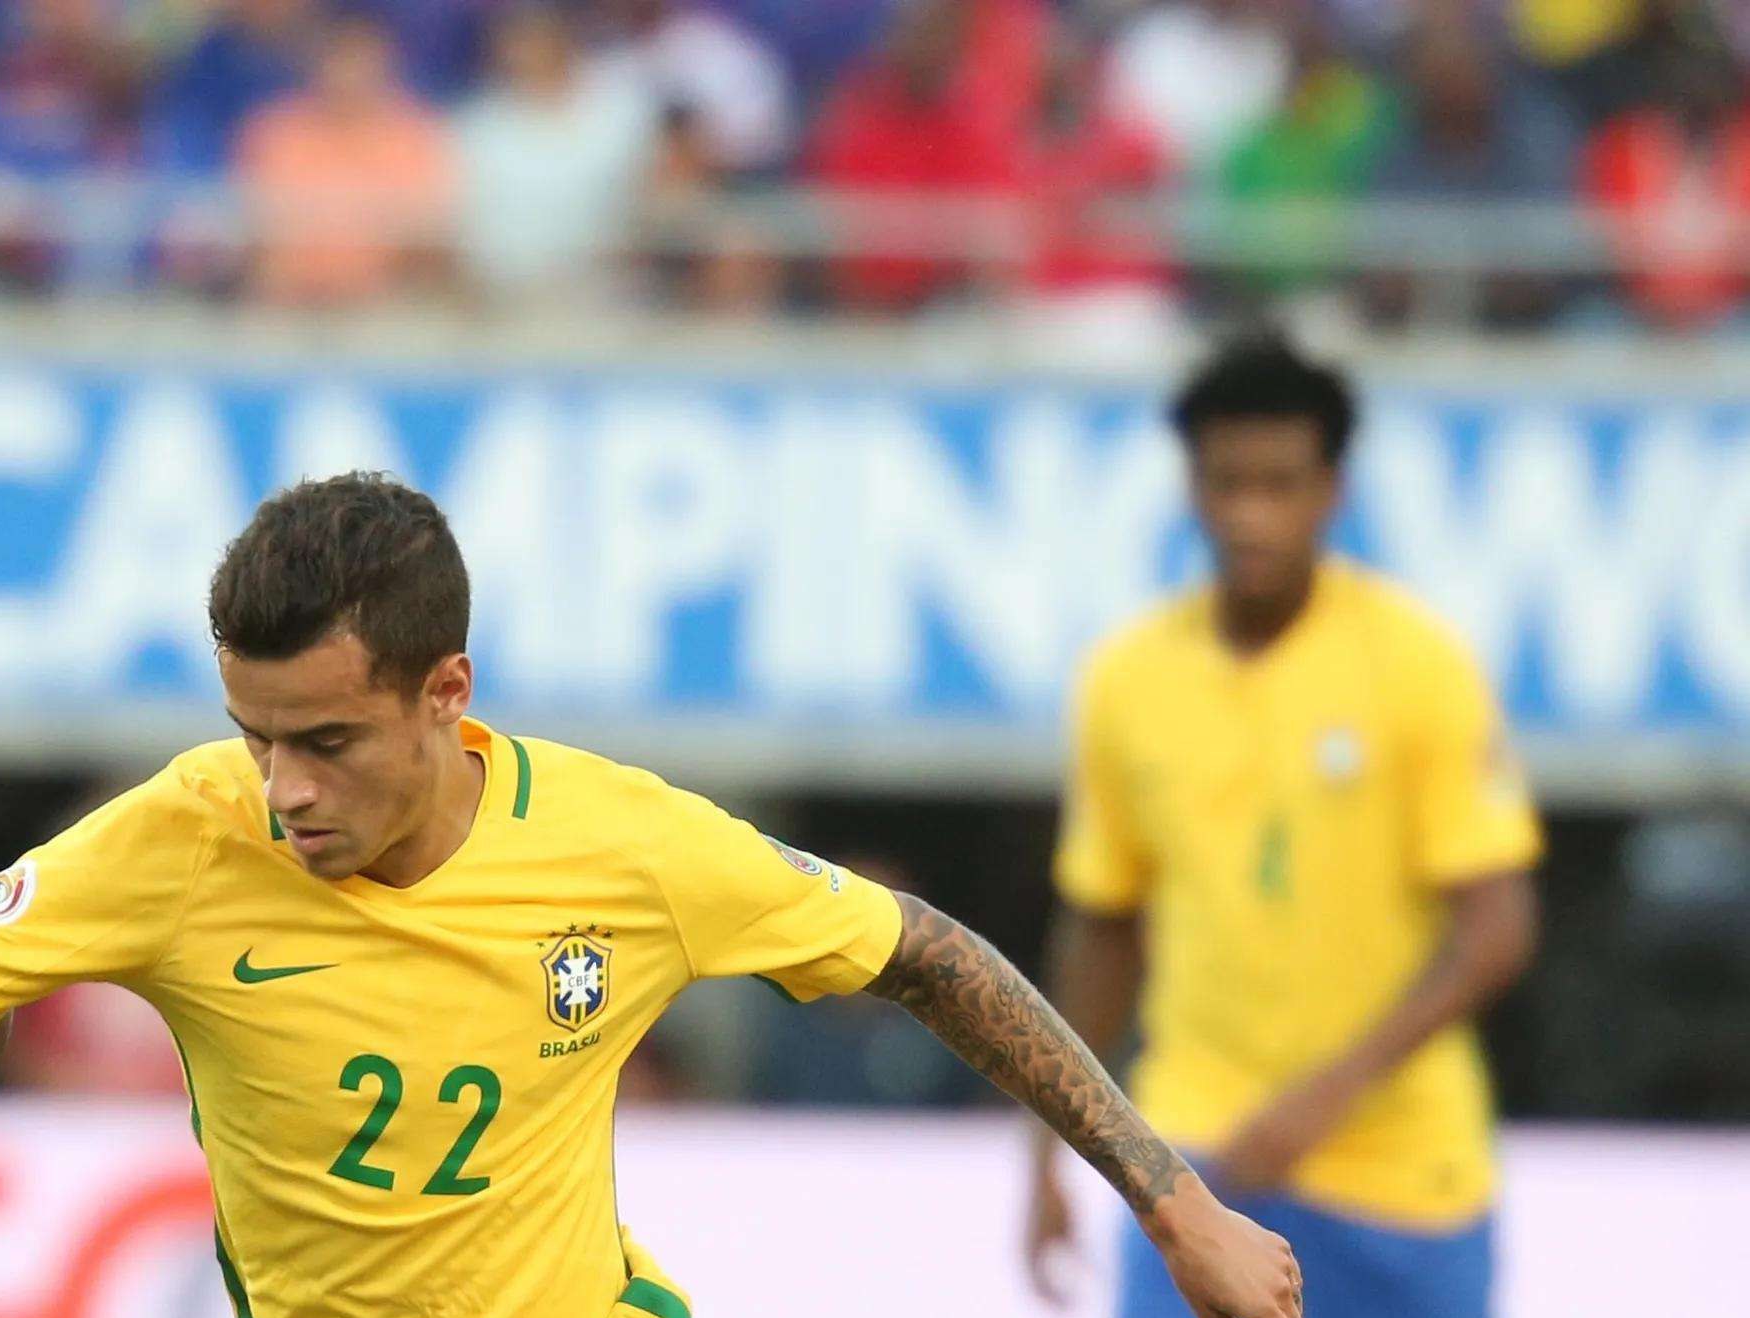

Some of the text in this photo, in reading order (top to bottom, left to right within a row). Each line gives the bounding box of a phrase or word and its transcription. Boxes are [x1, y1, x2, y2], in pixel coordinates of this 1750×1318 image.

[1345, 395, 1750, 708] W
[568, 973, 590, 988] CBF
[327, 1054, 502, 1196] 22
